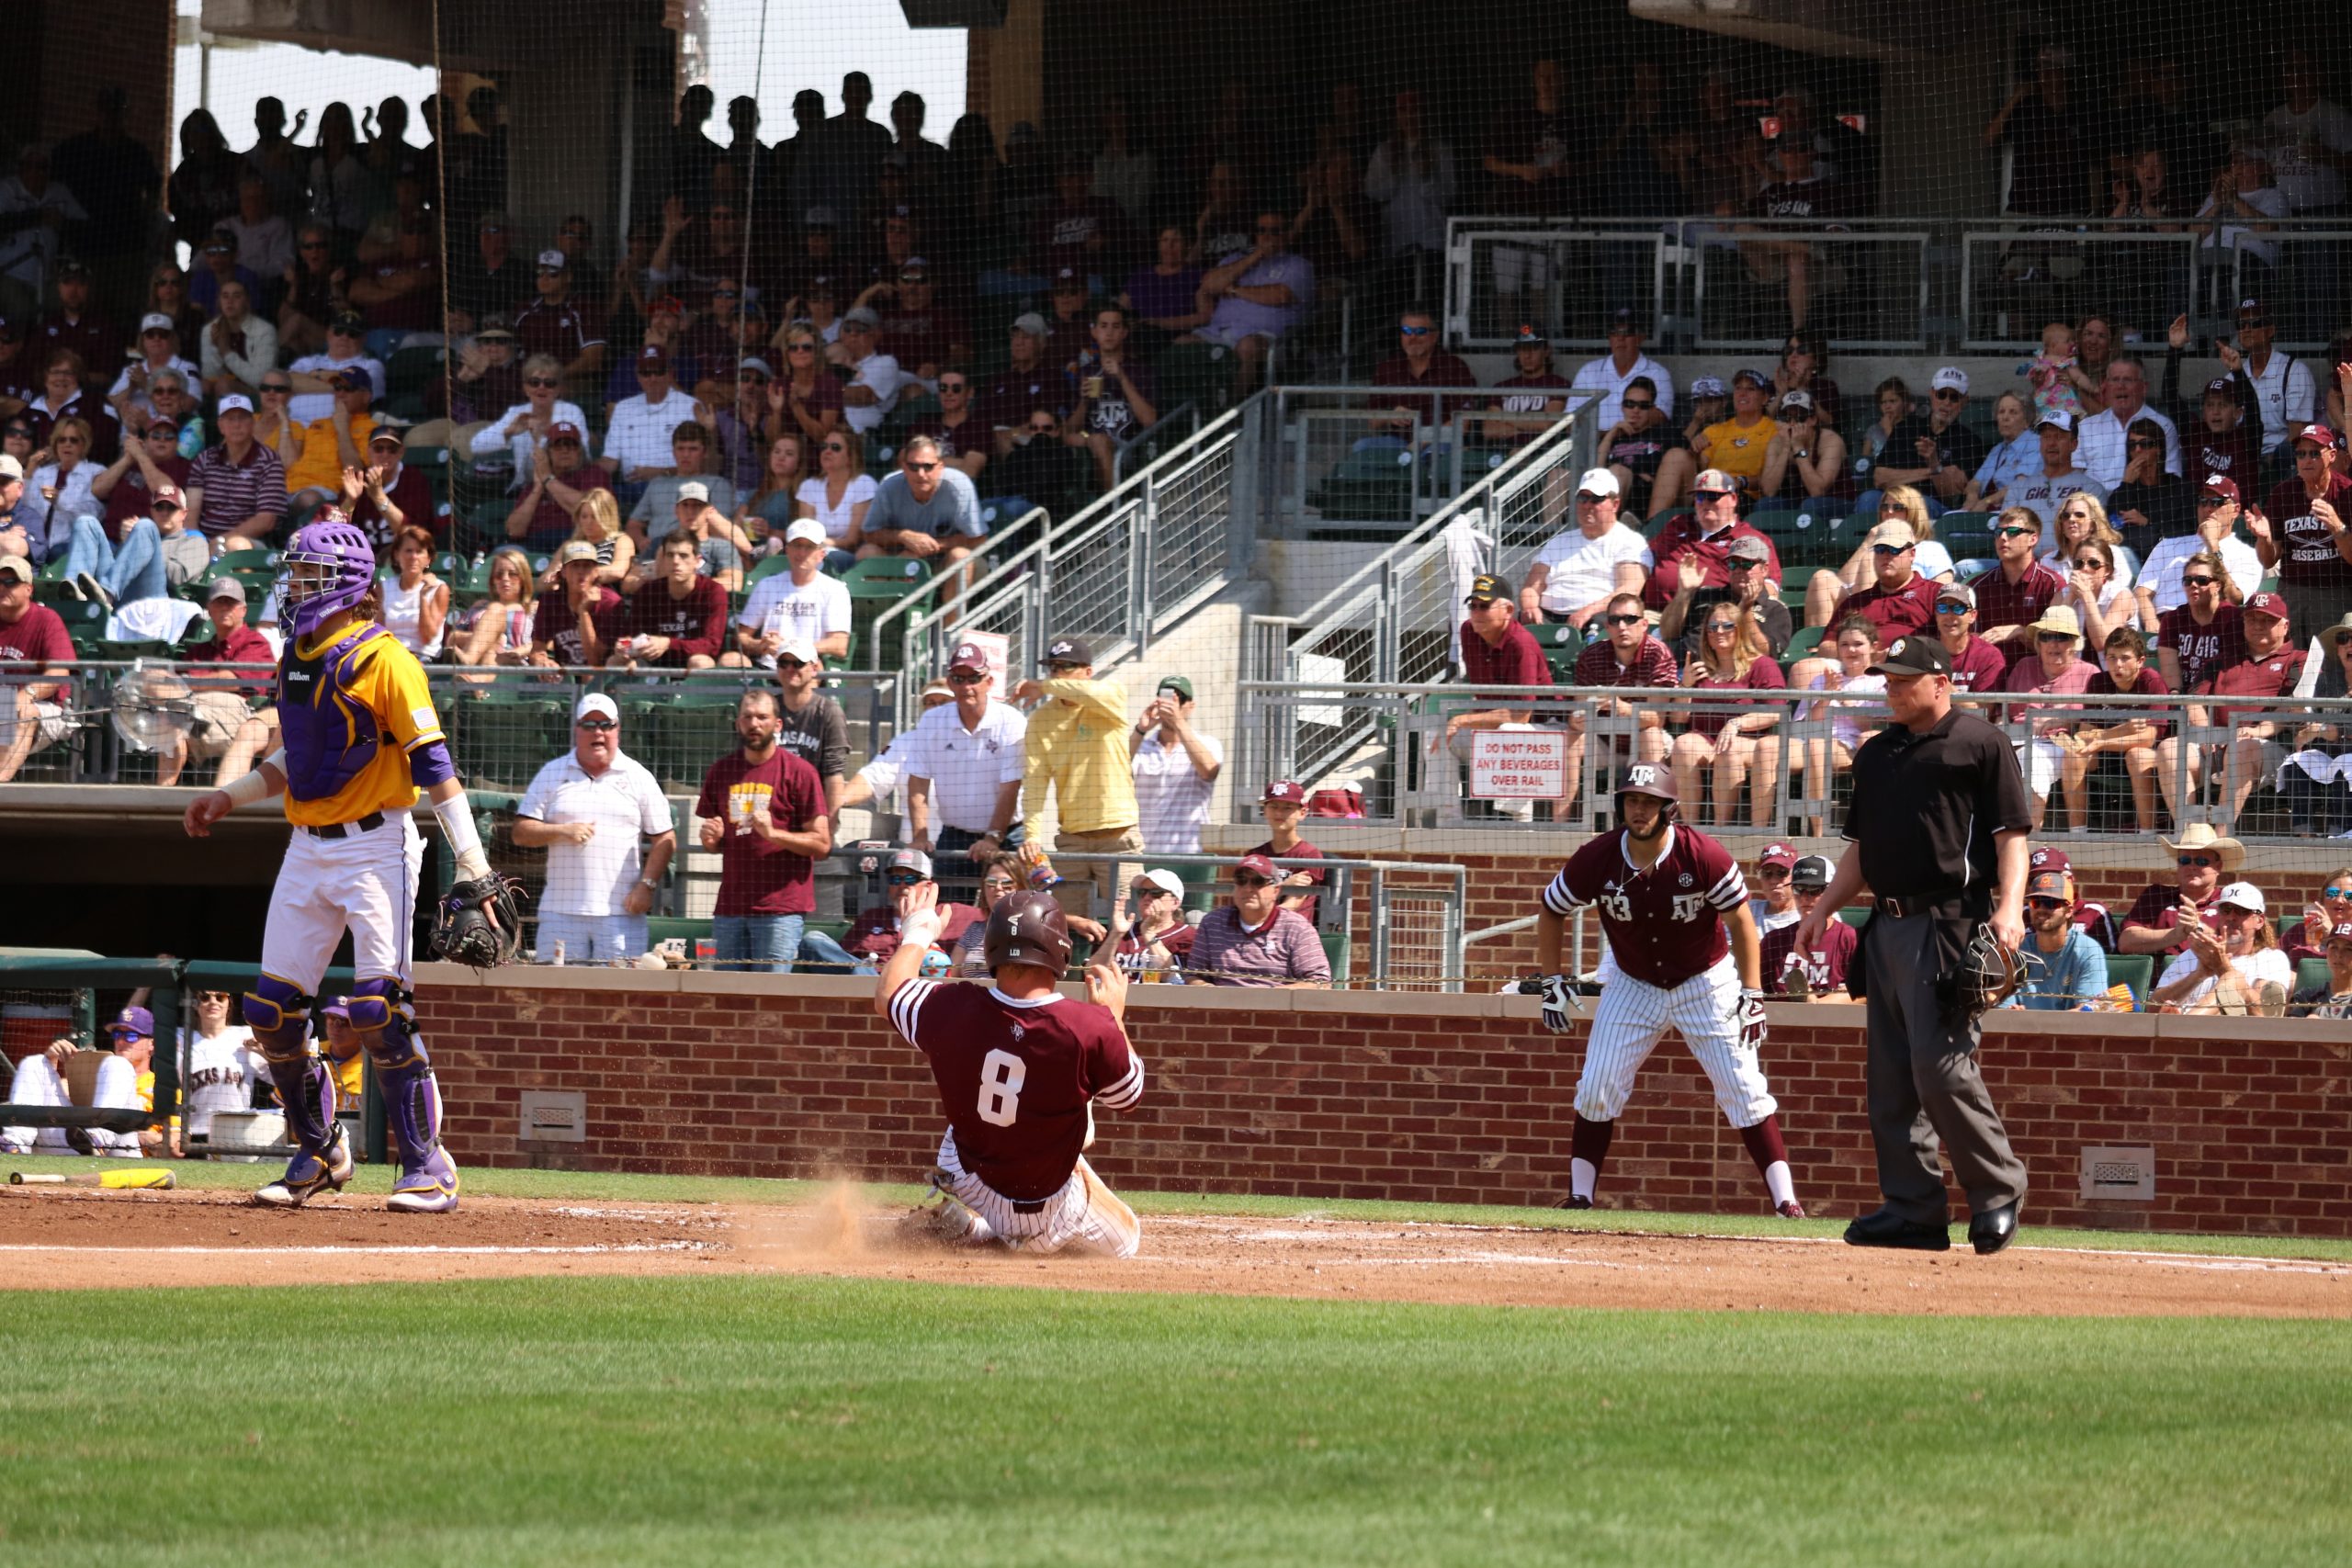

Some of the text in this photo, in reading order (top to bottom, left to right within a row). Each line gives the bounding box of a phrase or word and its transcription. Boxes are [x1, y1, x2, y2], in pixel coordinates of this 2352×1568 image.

[2210, 379, 2223, 389] 12
[2284, 516, 2319, 535] TEXAS
[319, 604, 339, 618] Wilson
[2189, 656, 2199, 669] OR
[288, 671, 311, 682] Wilson
[1485, 743, 1552, 754] DO NOT PASS
[1476, 759, 1560, 771] ANY BEVERAGES
[1491, 775, 1544, 786] OVER RAIL
[1600, 895, 1633, 921] 33
[1011, 925, 1018, 936] 8
[2335, 923, 2352, 935] 12
[977, 1048, 1027, 1127] 8
